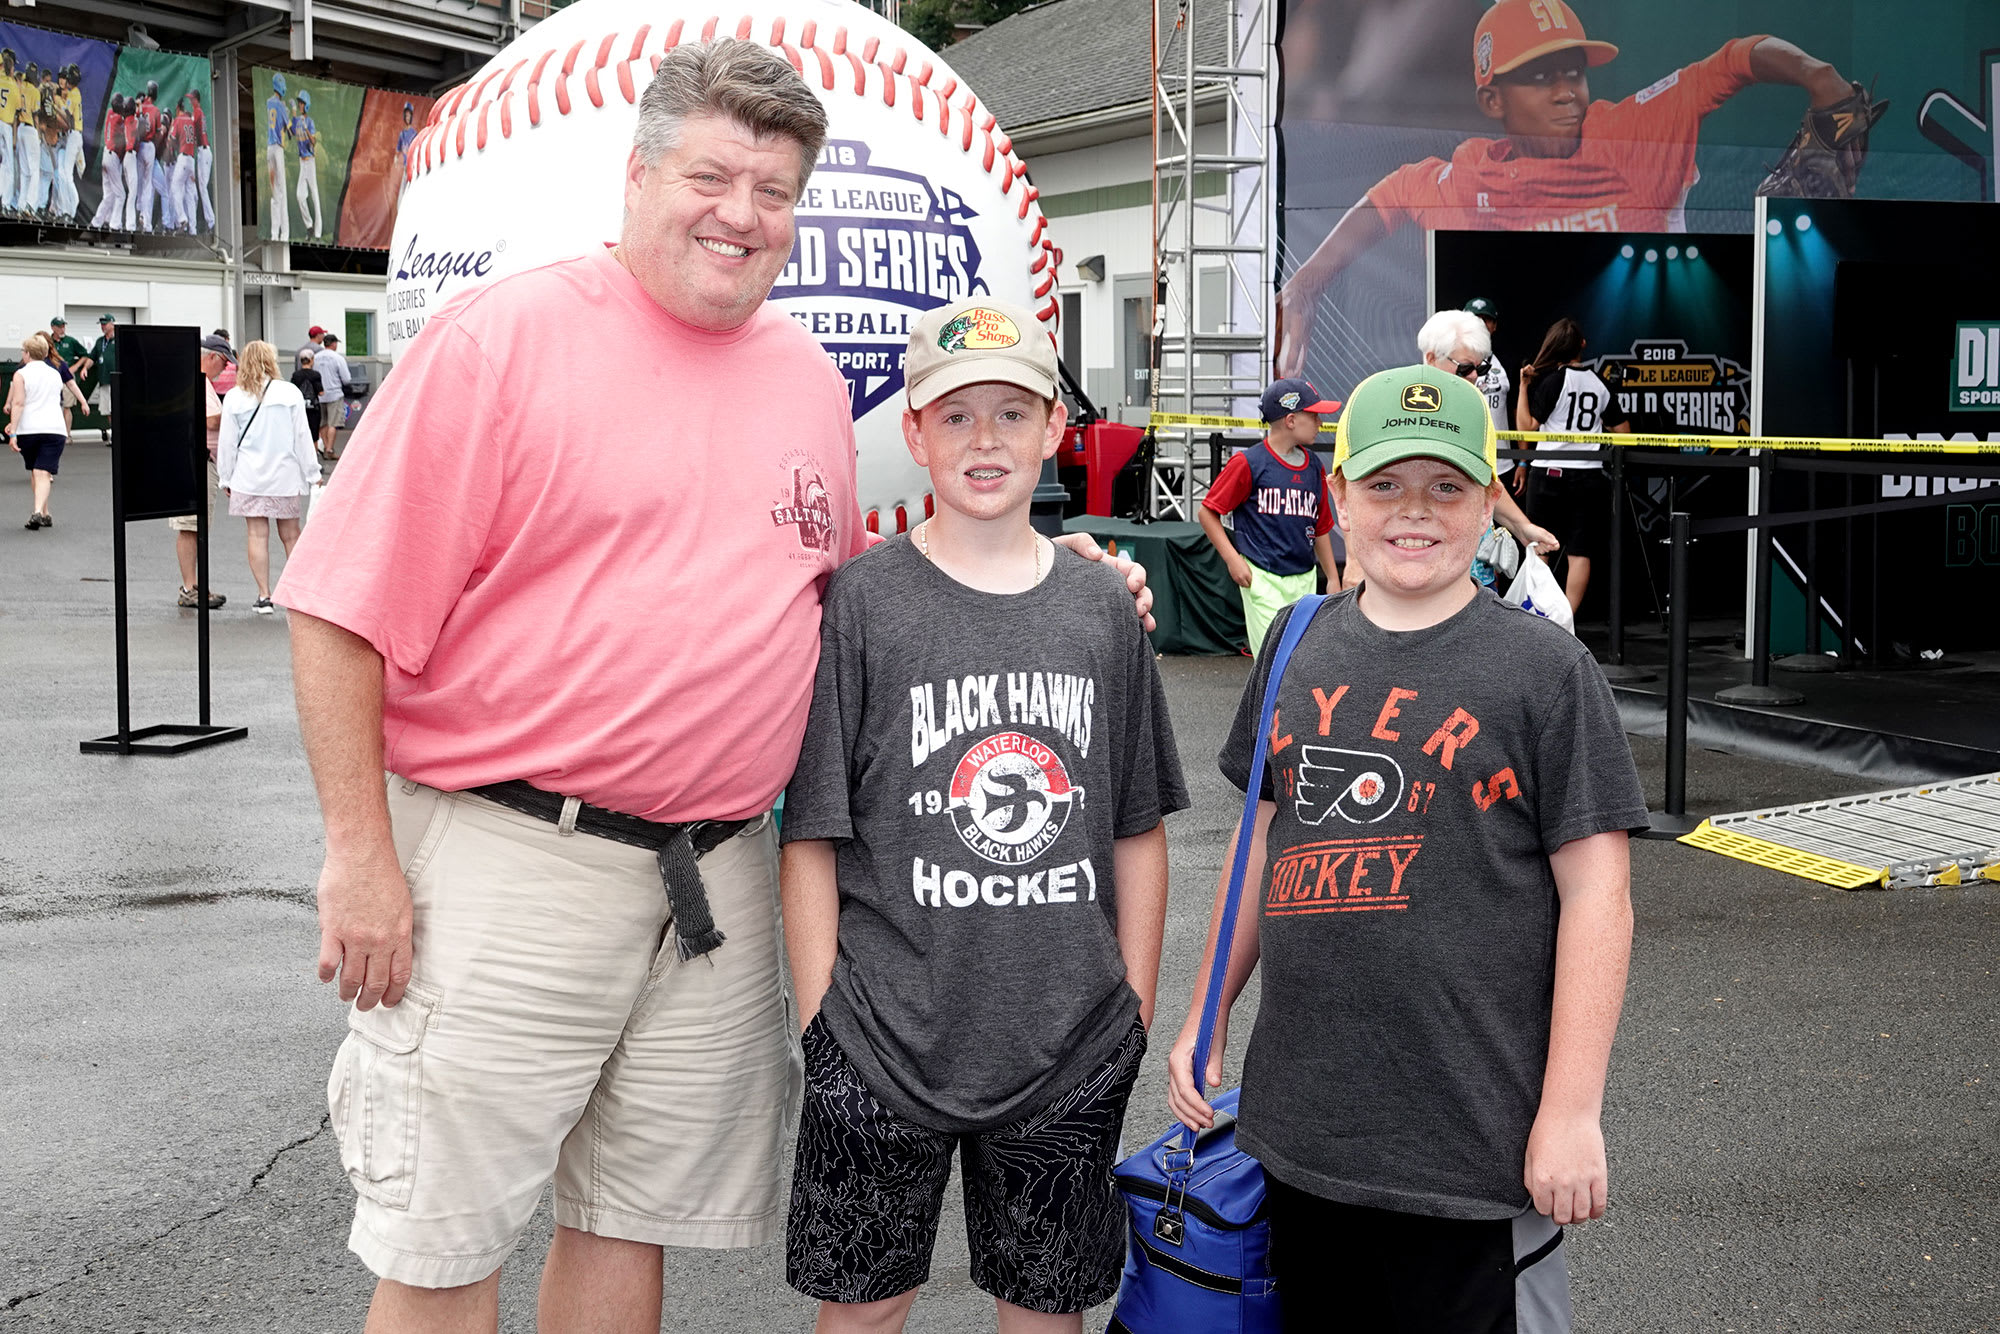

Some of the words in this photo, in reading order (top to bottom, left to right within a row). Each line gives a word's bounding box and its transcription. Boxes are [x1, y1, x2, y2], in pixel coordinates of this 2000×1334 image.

[832, 189, 923, 213] LEAGUE
[396, 233, 493, 293] League
[837, 227, 970, 300] SERIES
[398, 288, 425, 311] SERIES
[973, 309, 1006, 323] Bass
[975, 320, 999, 331] Pro
[975, 330, 1016, 344] Shops
[1643, 348, 1676, 361] 2018
[1134, 369, 1149, 380] EXIT
[1661, 369, 1709, 383] LEAGUE
[1567, 391, 1598, 431] 18
[1382, 417, 1417, 429] JOHN
[1419, 416, 1460, 433] DEERE
[910, 674, 1002, 768] BLACK
[1007, 671, 1094, 759] HAWKS
[967, 735, 1051, 769] WATERLOO
[908, 789, 942, 815] 19
[1407, 781, 1436, 815] 67
[962, 822, 1010, 862] BLACK
[1015, 819, 1059, 862] HAWKS
[1267, 850, 1419, 903] HOCKEY
